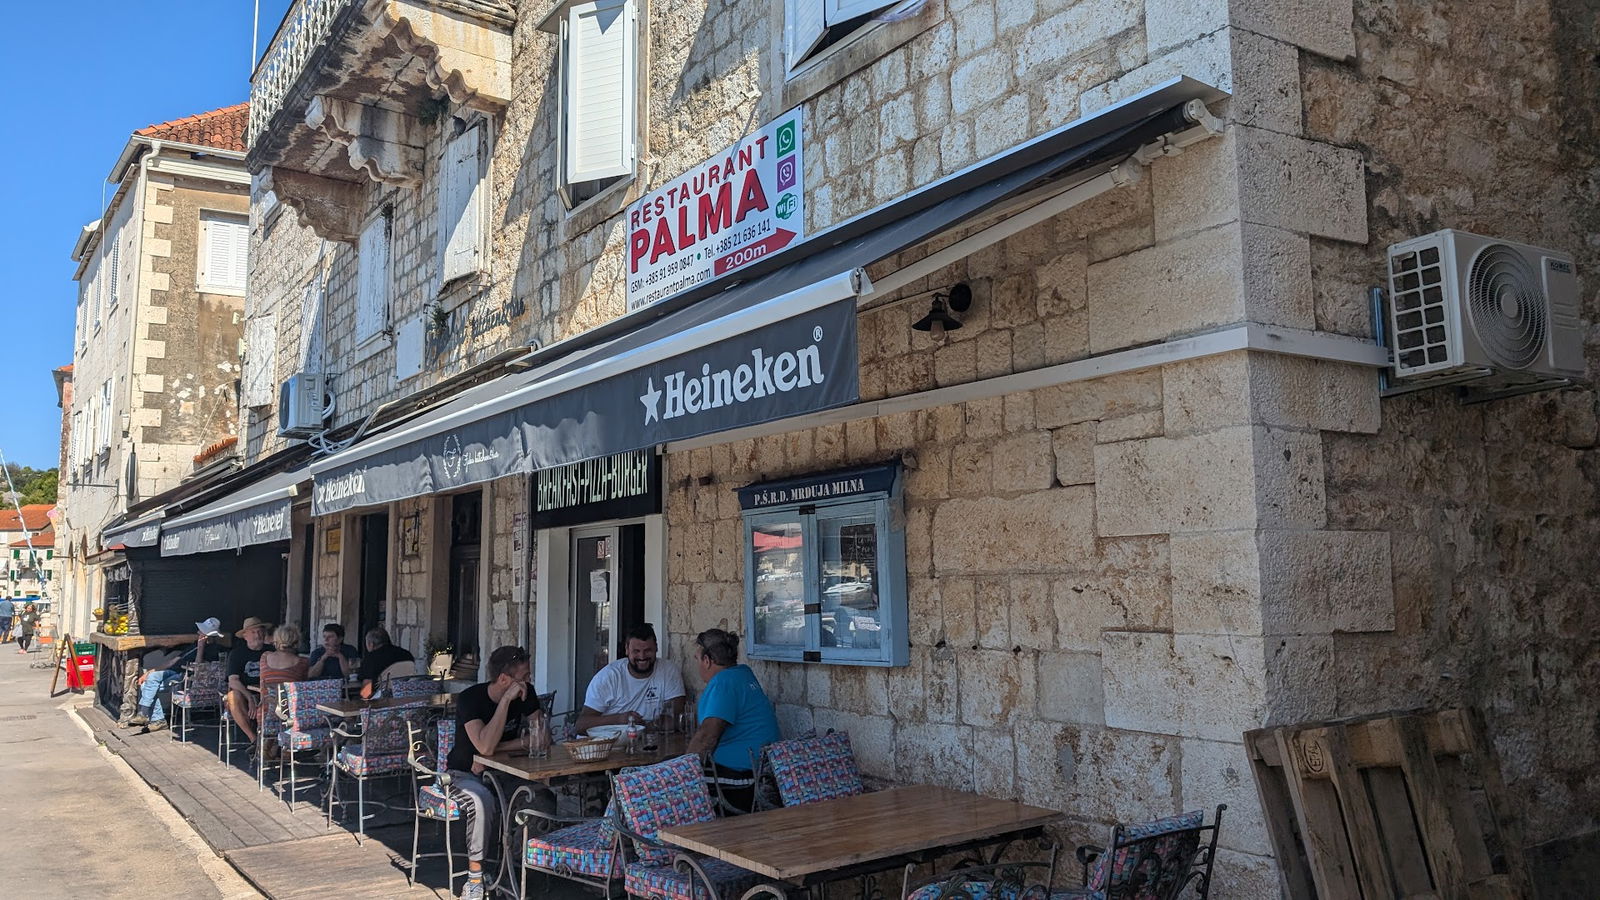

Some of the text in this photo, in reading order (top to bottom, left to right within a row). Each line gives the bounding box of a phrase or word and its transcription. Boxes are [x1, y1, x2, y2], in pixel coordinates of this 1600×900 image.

[631, 135, 769, 230] RESTAURANT
[631, 168, 769, 274] PALMA
[646, 270, 659, 286] +385
[660, 267, 666, 280] 91
[667, 261, 679, 277] 959
[704, 244, 715, 259] Tel.
[716, 236, 732, 253] +385
[733, 231, 742, 246] 21
[743, 225, 756, 242] 636
[758, 218, 771, 235] 141
[725, 244, 767, 270] 200m
[631, 268, 711, 310] www.restaurantpalma.com
[791, 484, 830, 500] MRDUJA
[832, 478, 865, 495] MILNA
